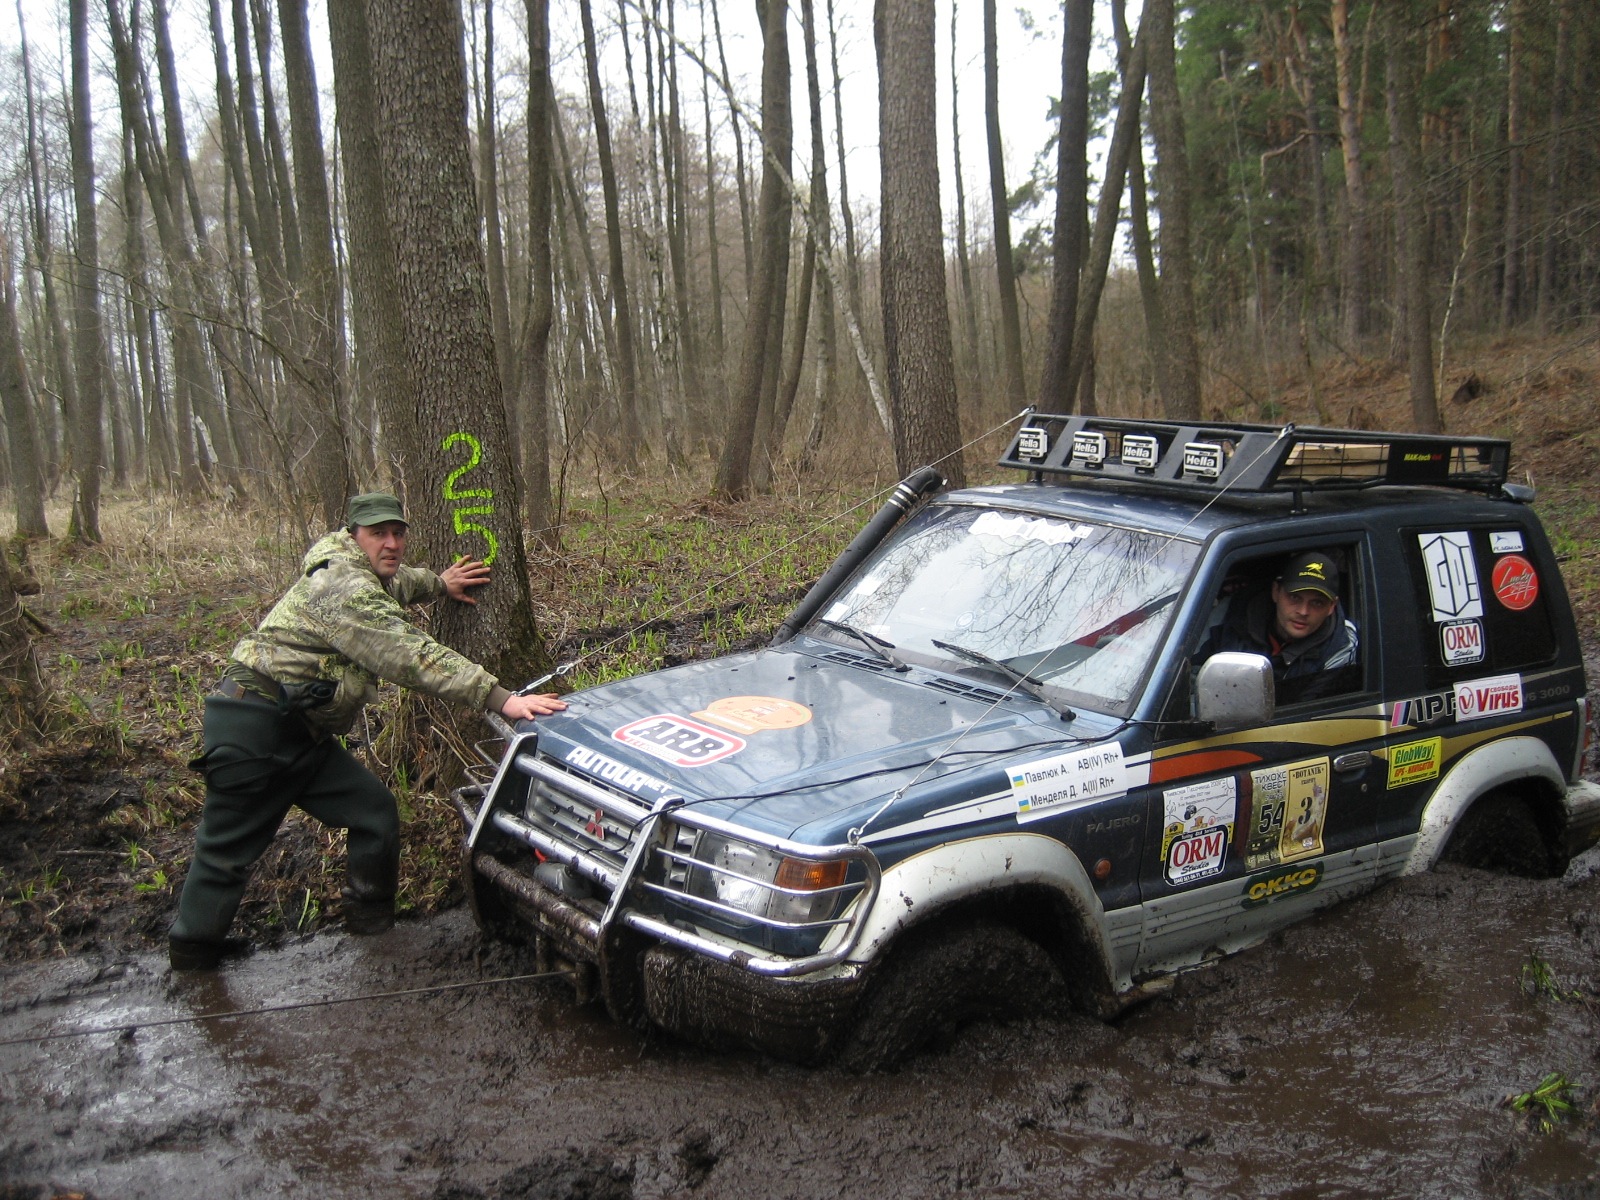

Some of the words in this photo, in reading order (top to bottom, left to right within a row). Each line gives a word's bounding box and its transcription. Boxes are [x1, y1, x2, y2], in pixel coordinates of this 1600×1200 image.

[1019, 438, 1039, 449] Hella
[1074, 442, 1097, 454] Hella
[1124, 446, 1150, 458] Hella
[1186, 455, 1215, 467] Hella
[1445, 624, 1479, 650] ORM
[1476, 688, 1519, 713] Virus
[1540, 685, 1571, 699] 3000
[628, 721, 725, 758] ARB
[1025, 769, 1059, 784] Павлюк
[1104, 752, 1119, 765] Rh+
[1030, 790, 1068, 807] Менделя
[1099, 777, 1115, 790] Rh+
[1262, 780, 1287, 791] КВЕСТ
[1258, 800, 1285, 834] 54
[1298, 797, 1312, 824] 3
[1087, 815, 1141, 834] PAJERO
[1173, 832, 1222, 867] ORM
[1180, 861, 1210, 875] Studio
